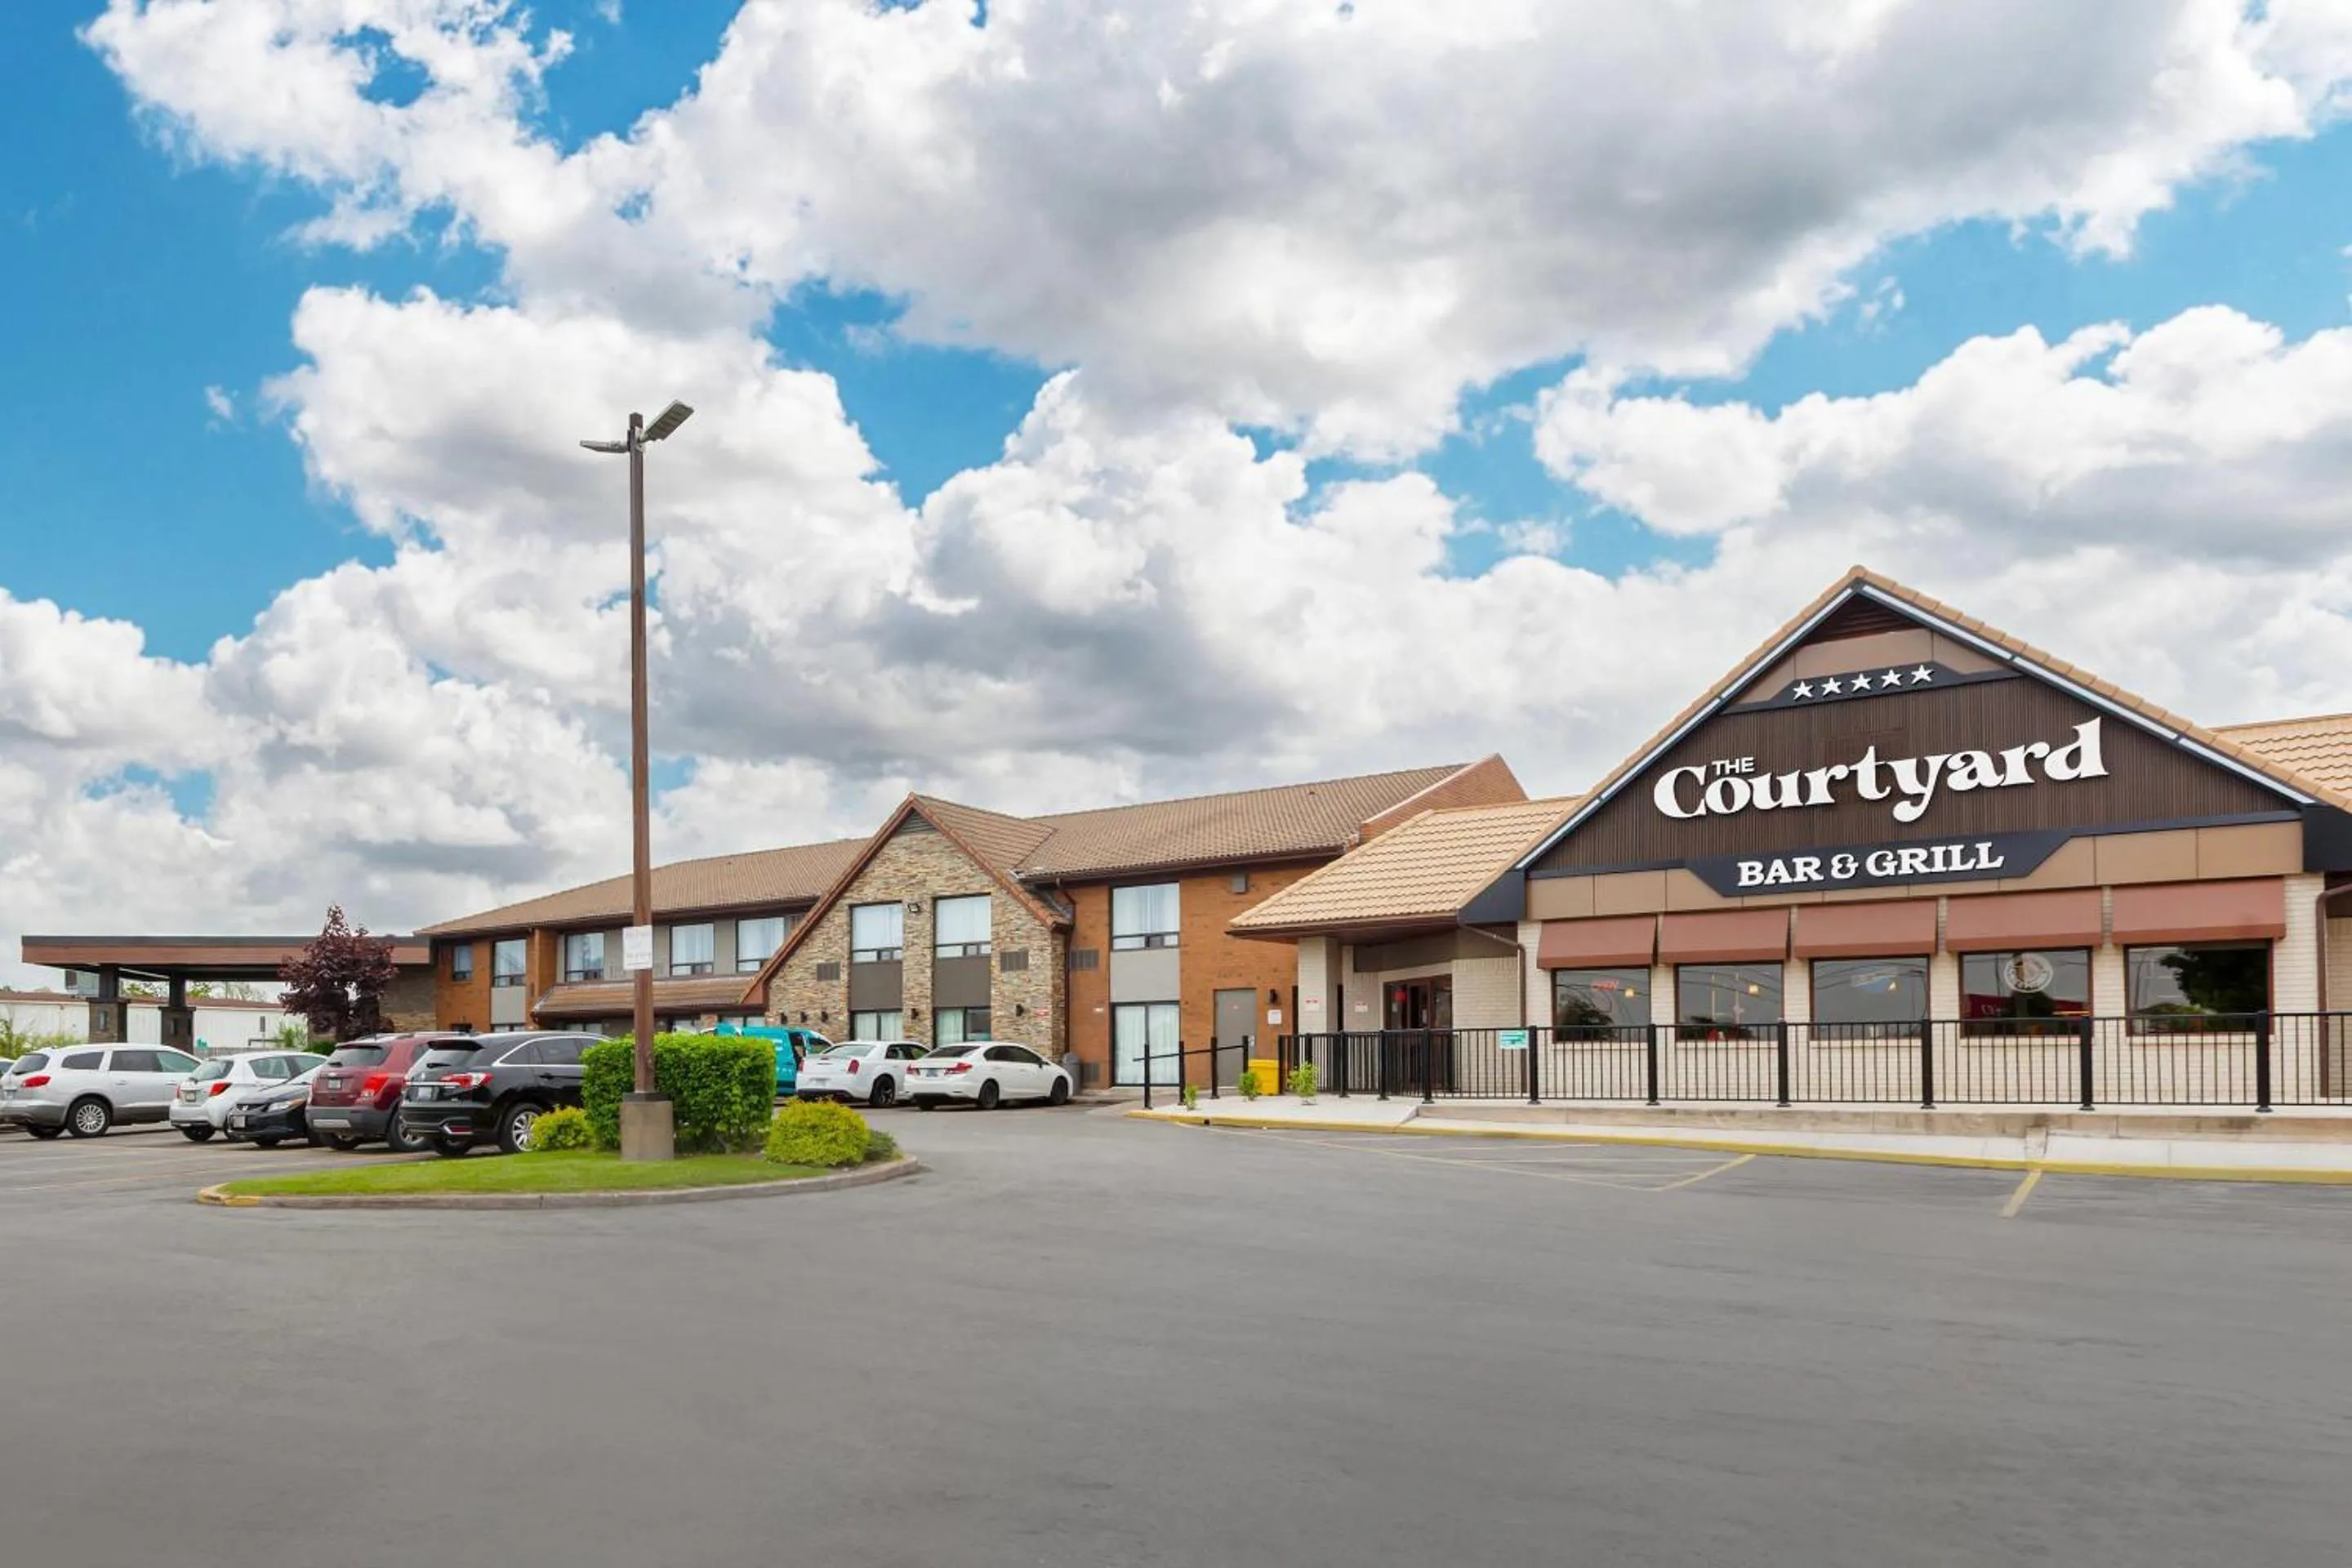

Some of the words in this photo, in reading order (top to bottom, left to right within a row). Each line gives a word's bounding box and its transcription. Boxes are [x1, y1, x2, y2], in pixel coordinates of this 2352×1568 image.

[1654, 716, 2109, 822] Courtyard
[1711, 756, 1755, 776] THE
[1737, 857, 1824, 887] BAR
[1831, 853, 1859, 880] &
[1865, 841, 2005, 878] GRILL
